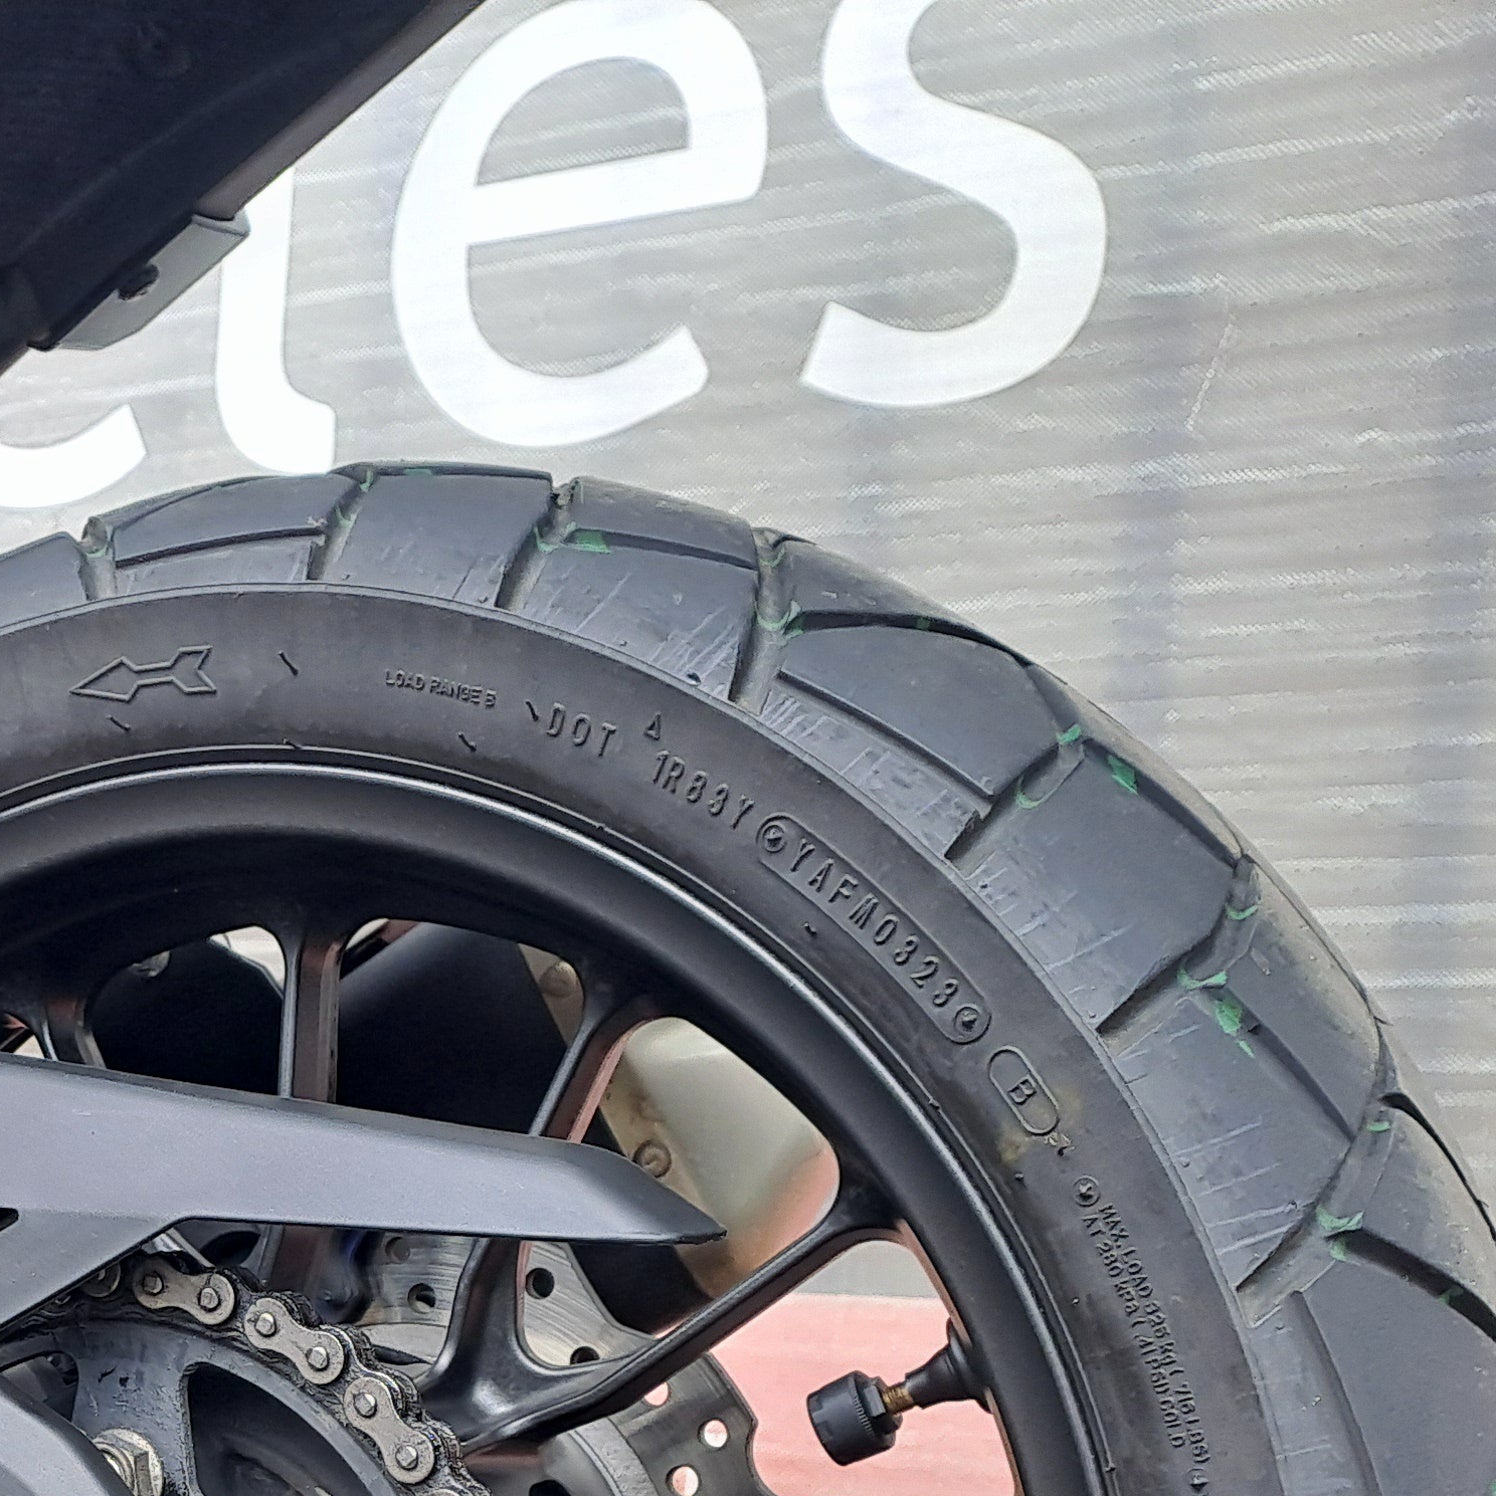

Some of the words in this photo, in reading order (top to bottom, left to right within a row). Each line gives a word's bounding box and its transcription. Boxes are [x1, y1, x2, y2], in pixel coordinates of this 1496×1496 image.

[385, 669, 424, 692] LOAD
[429, 677, 483, 705] RANGE
[546, 701, 617, 758] DOT
[1120, 1248, 1154, 1299] LOAD
